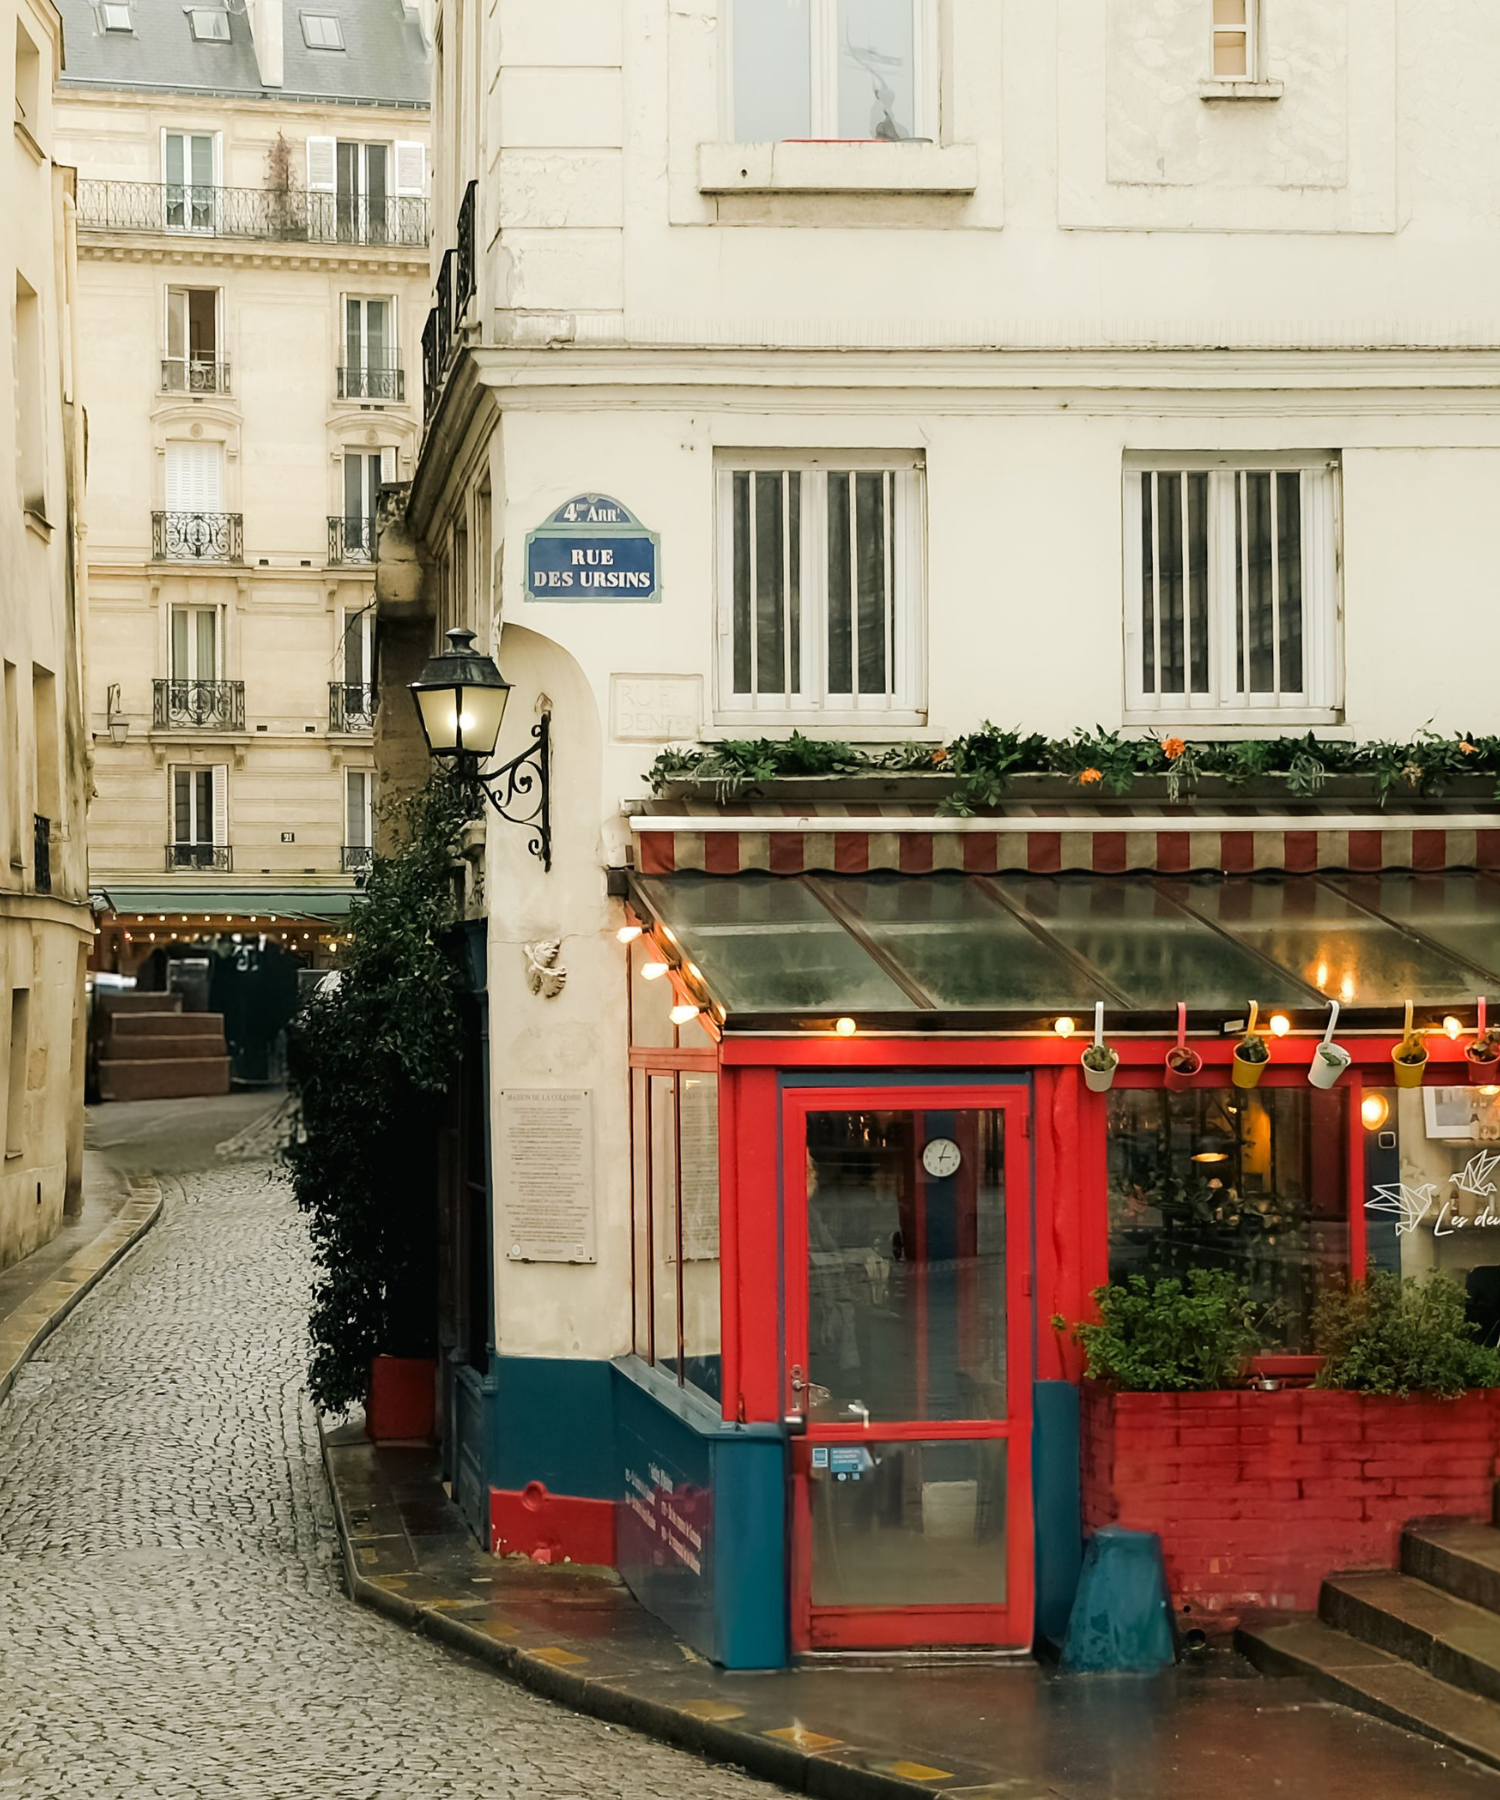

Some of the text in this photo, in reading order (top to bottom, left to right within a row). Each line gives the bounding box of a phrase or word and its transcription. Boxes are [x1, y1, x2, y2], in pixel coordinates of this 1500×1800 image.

[571, 549, 614, 565] RUE
[534, 571, 651, 588] DES URSINS
[621, 684, 676, 707] RUE
[1433, 1201, 1469, 1236] Les
